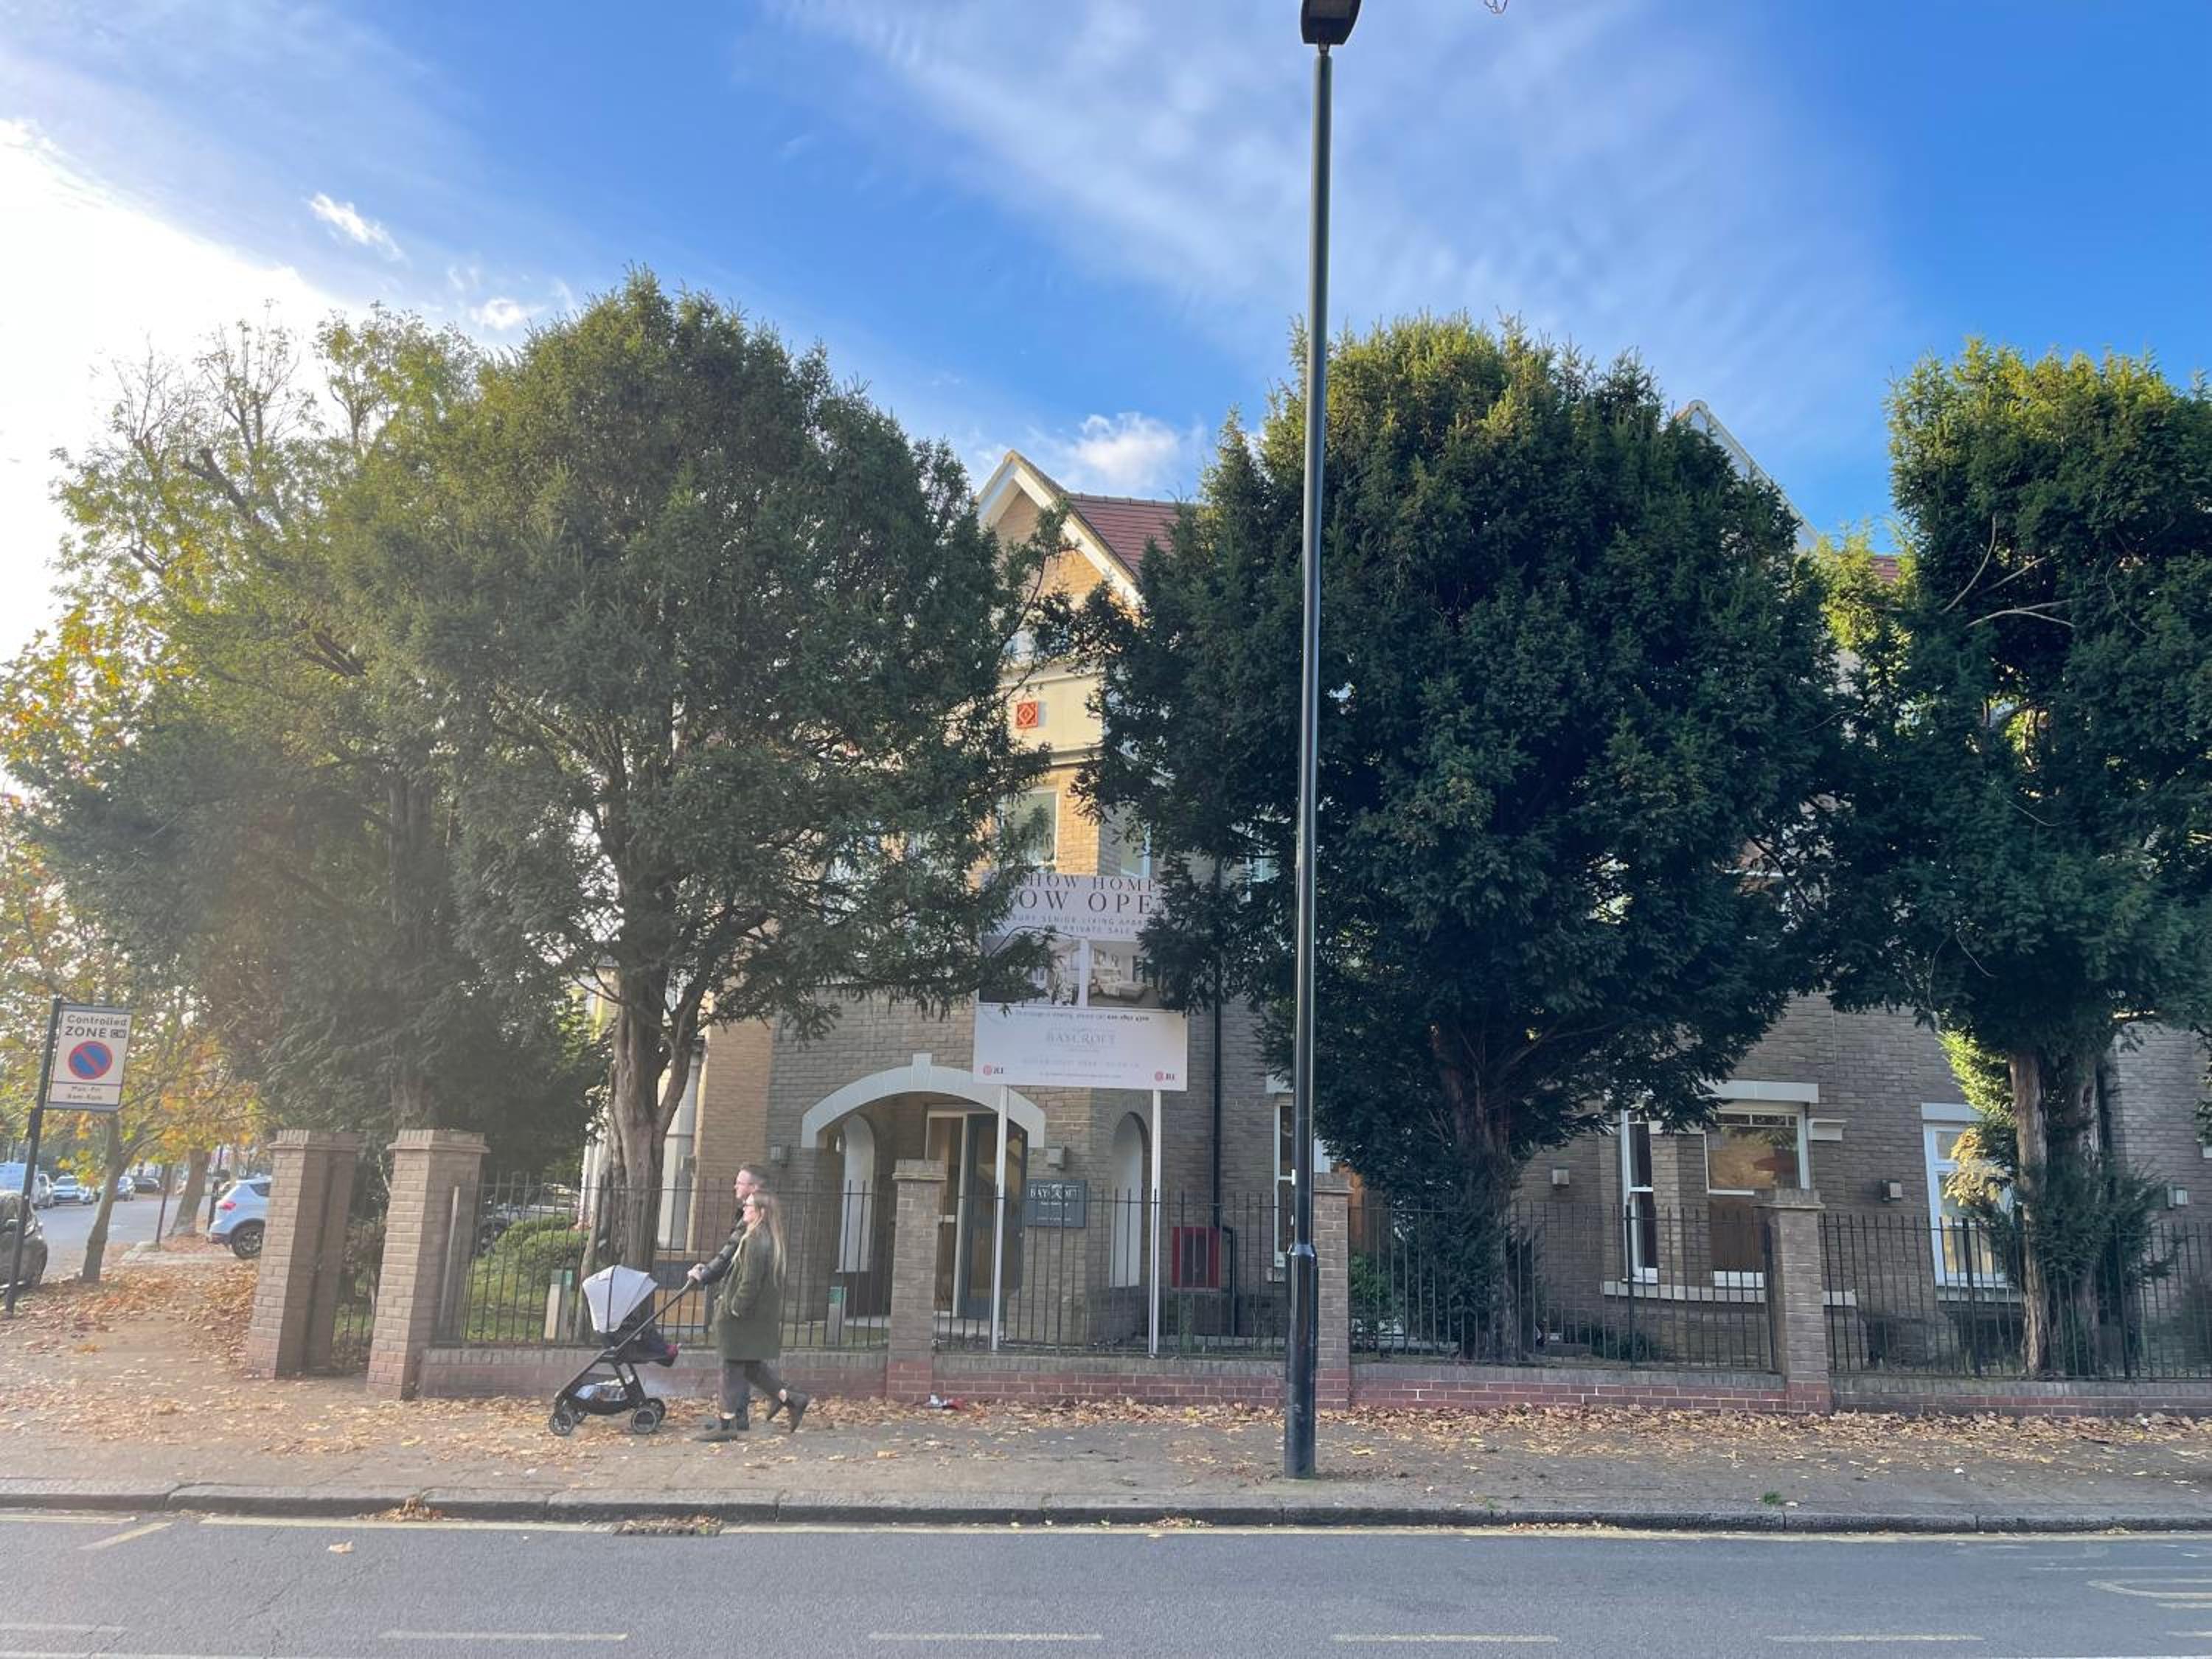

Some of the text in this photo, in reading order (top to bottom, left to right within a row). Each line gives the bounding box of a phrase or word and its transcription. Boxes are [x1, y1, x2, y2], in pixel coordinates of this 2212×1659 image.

[1022, 873, 1078, 888] HOW
[1018, 889, 1068, 910] OW
[67, 1015, 128, 1026] Controlled
[65, 1026, 107, 1038] ZONE
